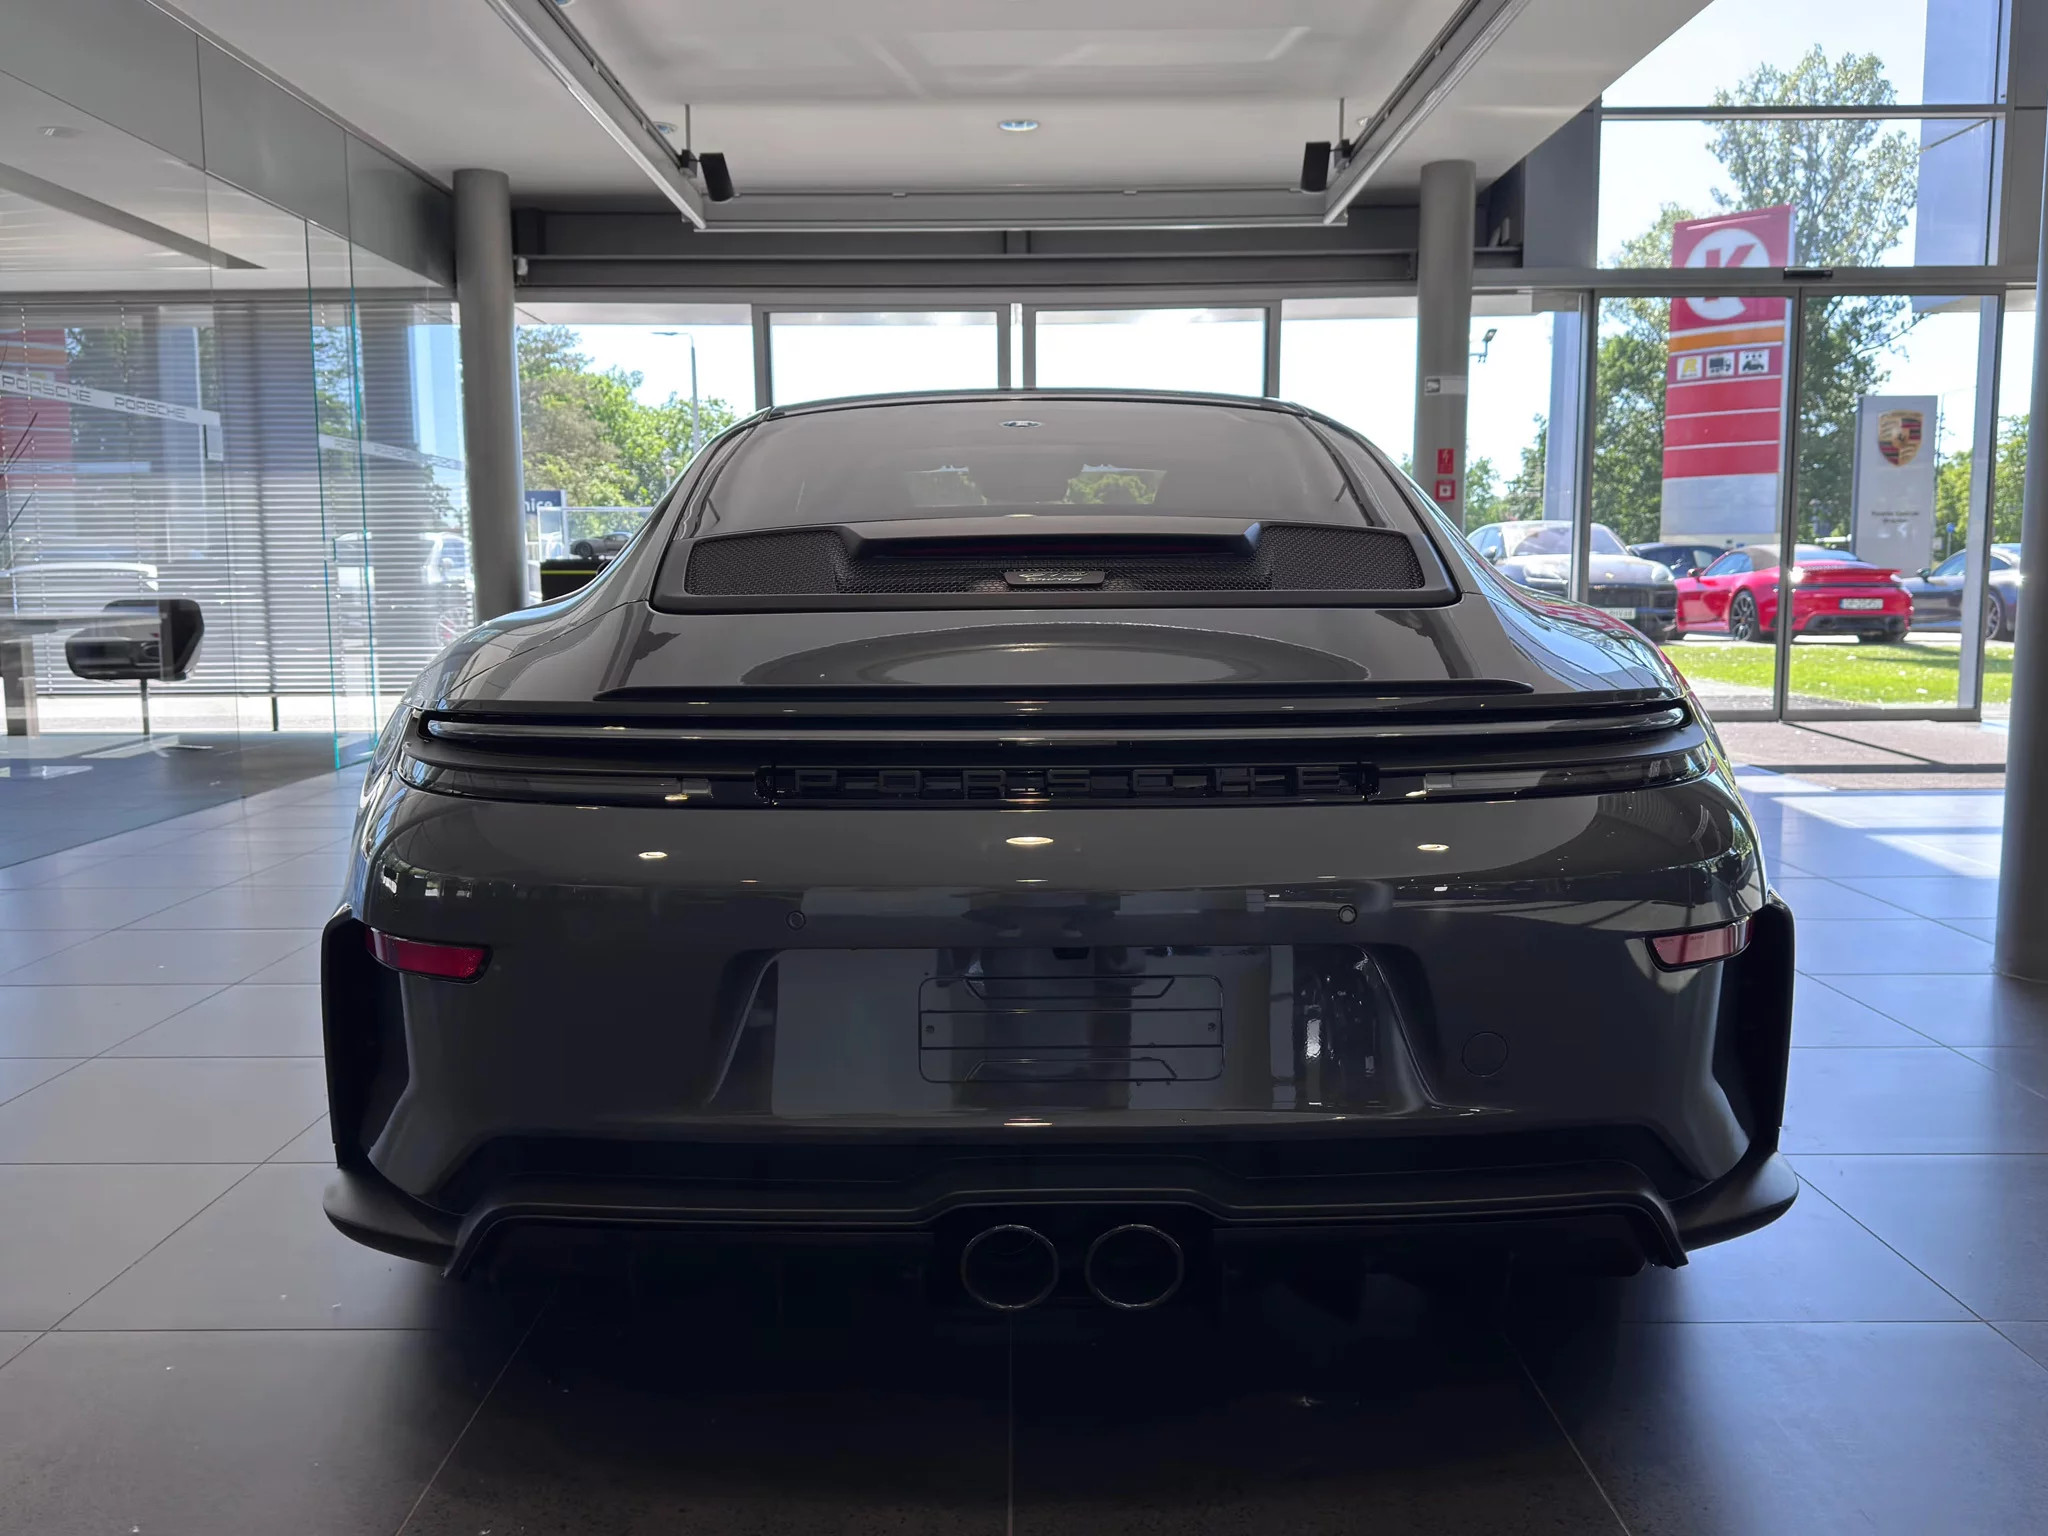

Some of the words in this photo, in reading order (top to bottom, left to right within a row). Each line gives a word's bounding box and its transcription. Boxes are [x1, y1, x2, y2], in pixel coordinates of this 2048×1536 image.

[2, 374, 91, 402] PORSCHE
[114, 396, 187, 419] PORSCHE
[793, 766, 1342, 798] PORSCHE
